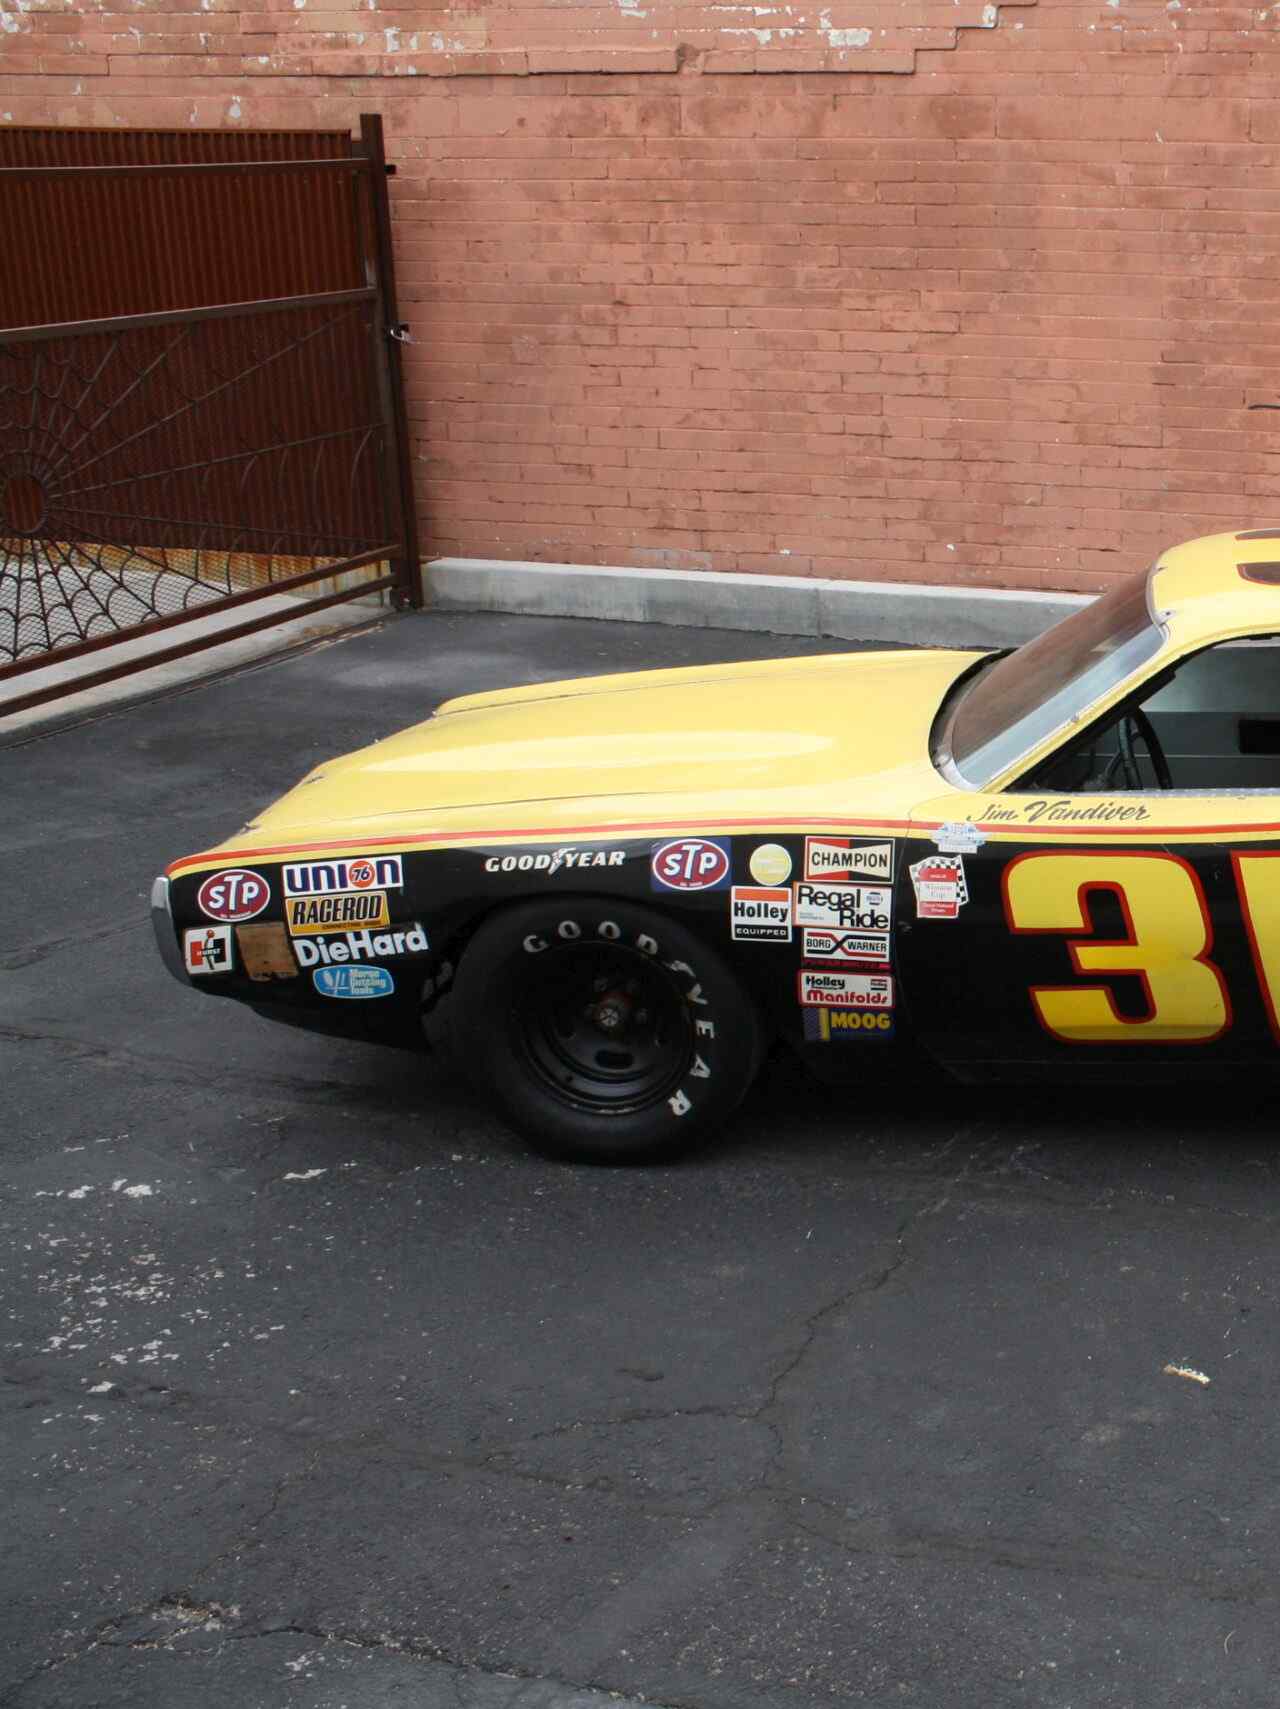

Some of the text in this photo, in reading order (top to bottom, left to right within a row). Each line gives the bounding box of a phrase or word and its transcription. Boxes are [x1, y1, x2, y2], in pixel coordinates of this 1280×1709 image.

[966, 799, 1152, 823] Jim Vandiver
[663, 844, 718, 880] STP
[811, 851, 888, 868] CHAMPION
[208, 874, 259, 911] STP
[797, 884, 861, 911] Regal
[292, 895, 382, 925] RACEROD
[734, 902, 788, 922] Holley
[839, 909, 889, 929] Ride
[736, 927, 787, 936] EQUIPPED
[292, 922, 429, 967] DieHard
[806, 938, 887, 953] BORG WARNER
[806, 975, 845, 990] Holley
[807, 990, 888, 1004] Manifolds
[831, 1012, 891, 1030] MOOG
